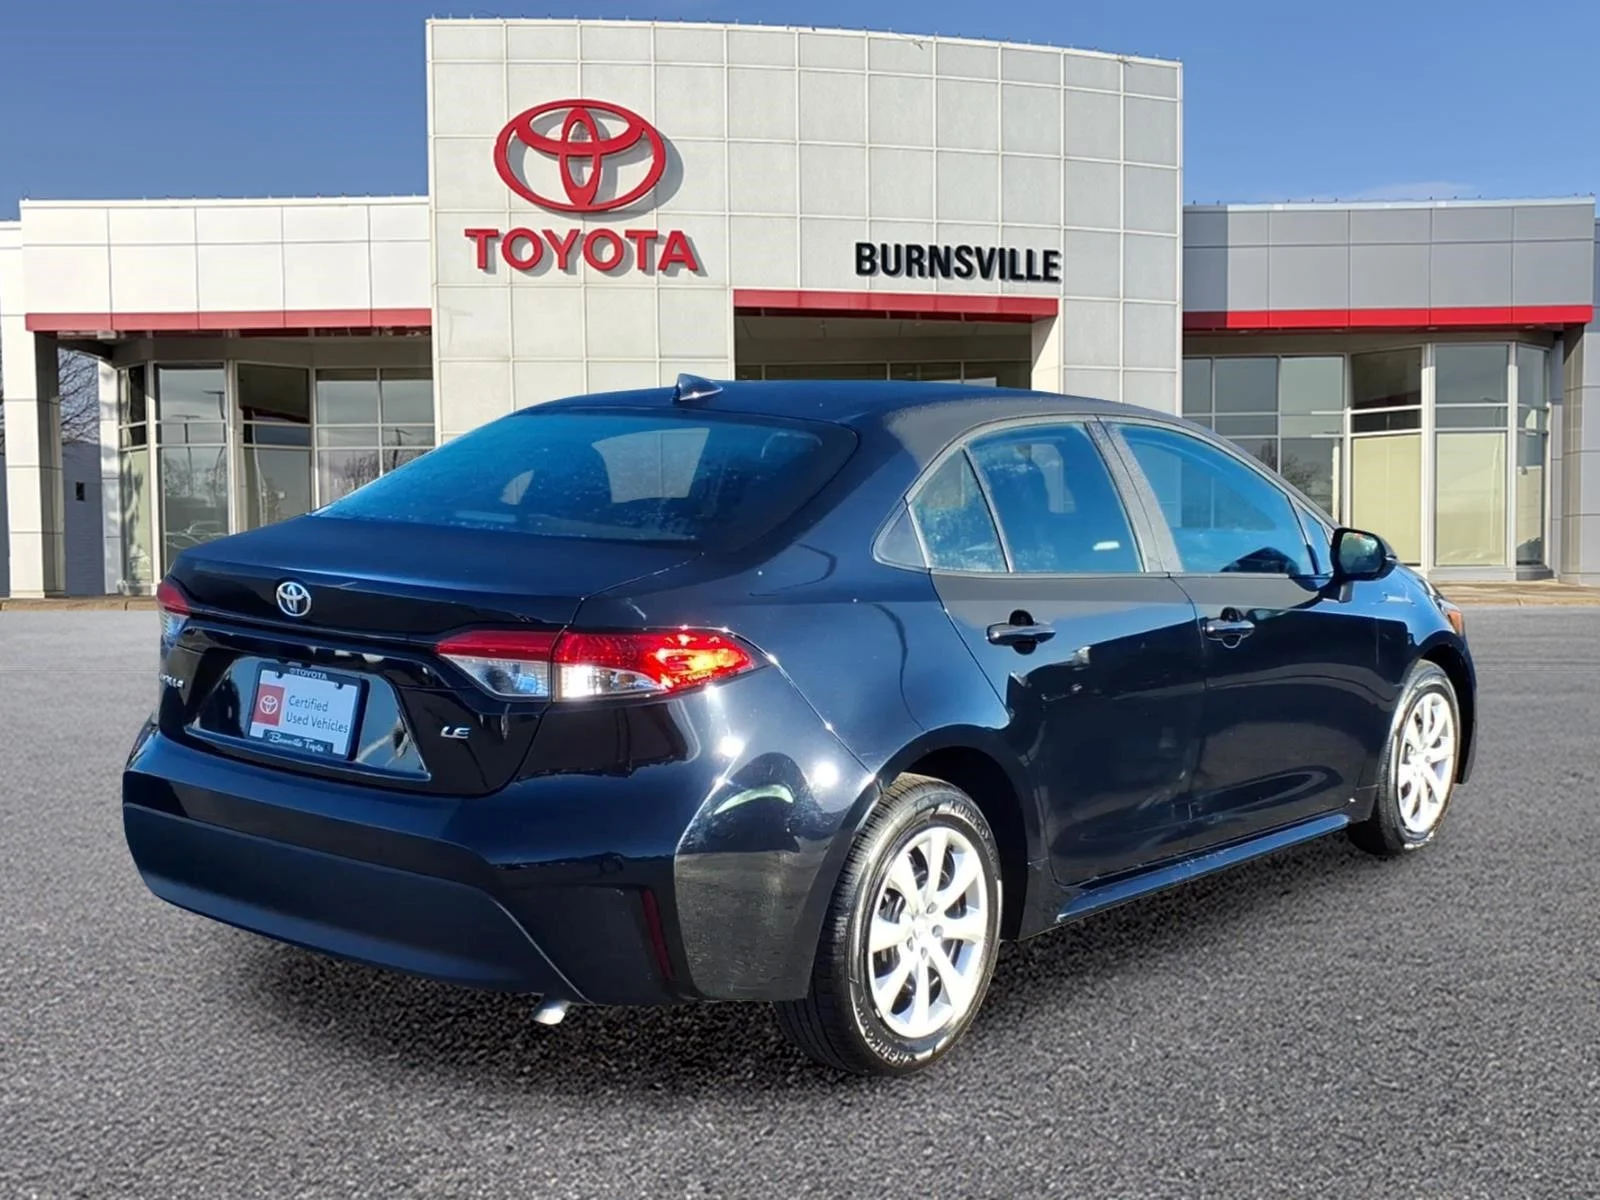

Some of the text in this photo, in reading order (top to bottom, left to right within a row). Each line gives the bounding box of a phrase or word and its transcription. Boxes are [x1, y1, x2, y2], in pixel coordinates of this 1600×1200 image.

[464, 228, 699, 271] TOYOTA
[855, 242, 1062, 282] BURNSVILLE
[296, 668, 328, 680] TOYOTA
[288, 695, 329, 712] Certified
[286, 711, 349, 733] Used Vehicles
[441, 726, 470, 739] LE
